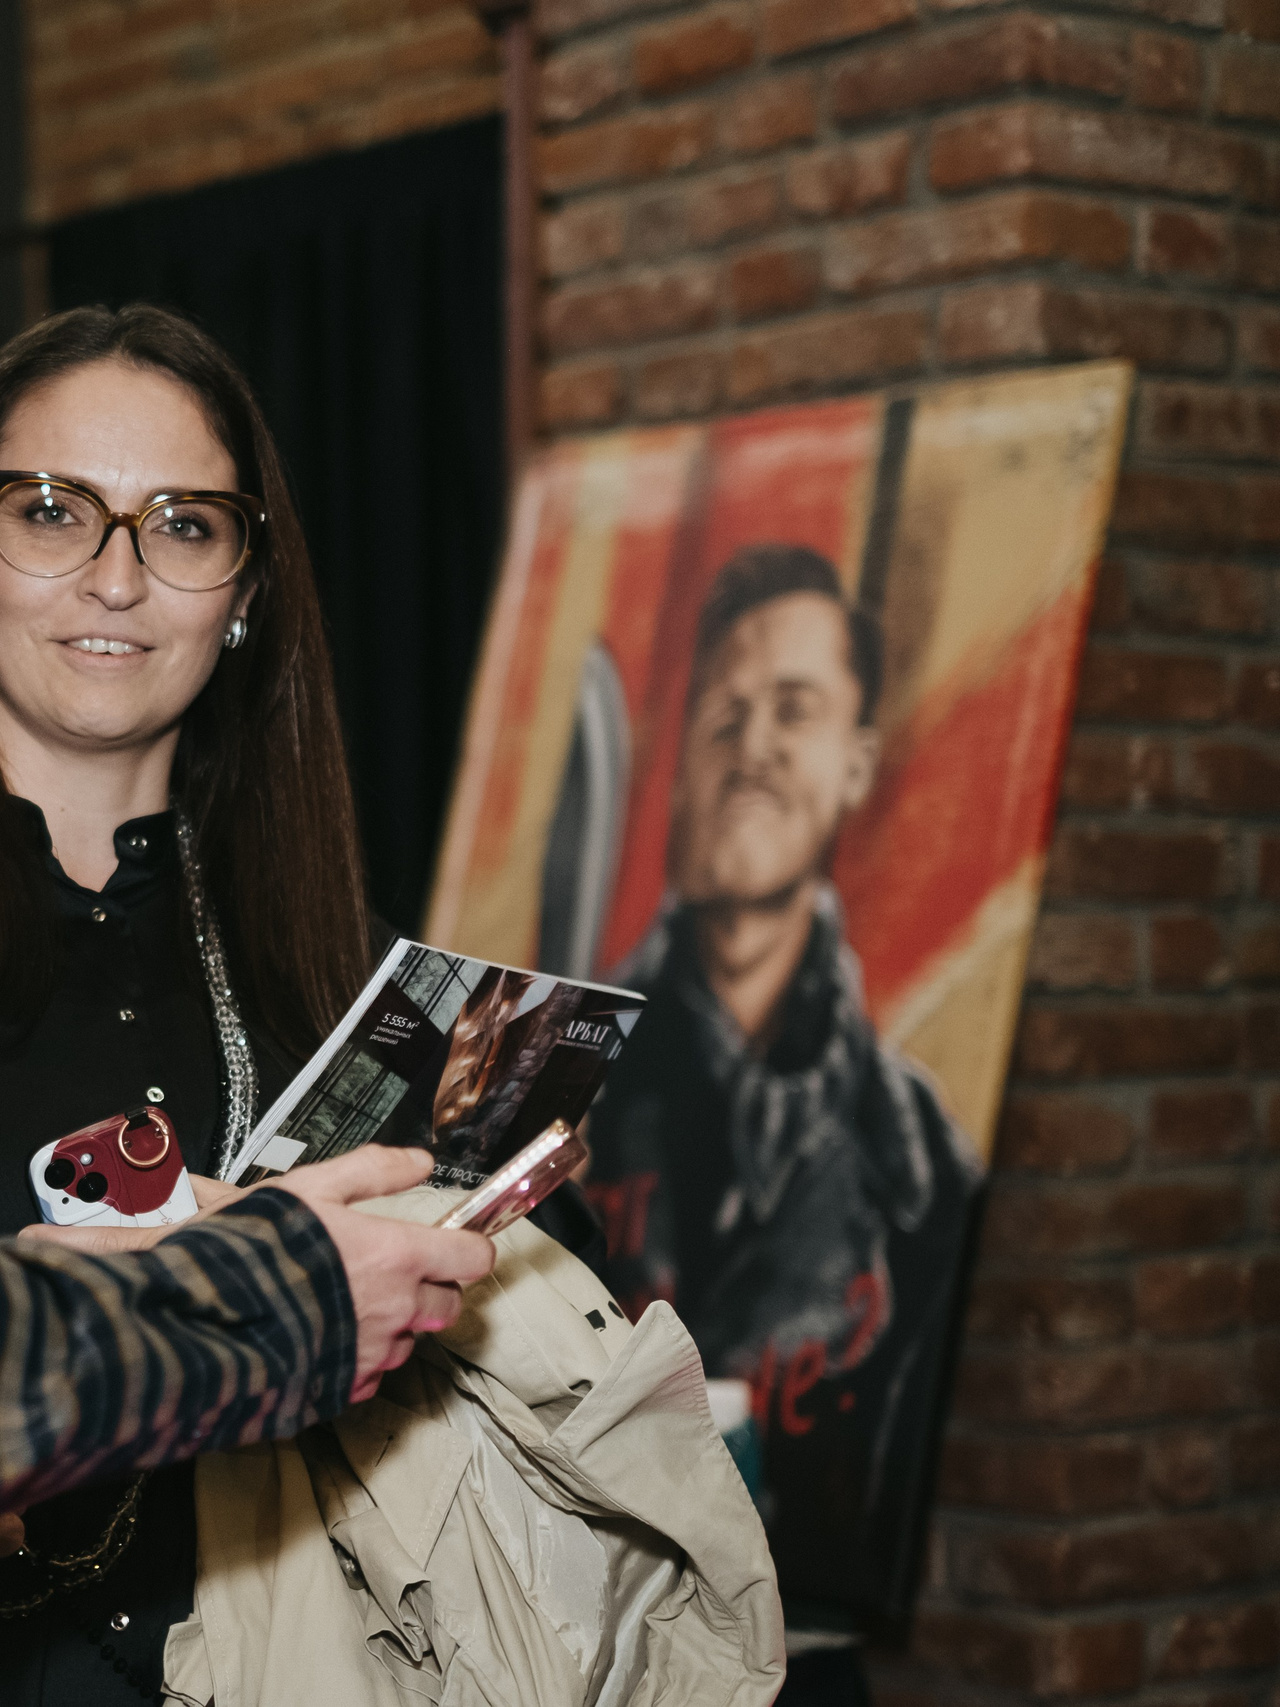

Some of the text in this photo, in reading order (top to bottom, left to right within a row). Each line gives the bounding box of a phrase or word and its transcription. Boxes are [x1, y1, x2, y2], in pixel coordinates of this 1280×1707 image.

[381, 1013, 391, 1023] 5
[389, 1015, 408, 1028] 555
[563, 1020, 612, 1044] АРБАТ
